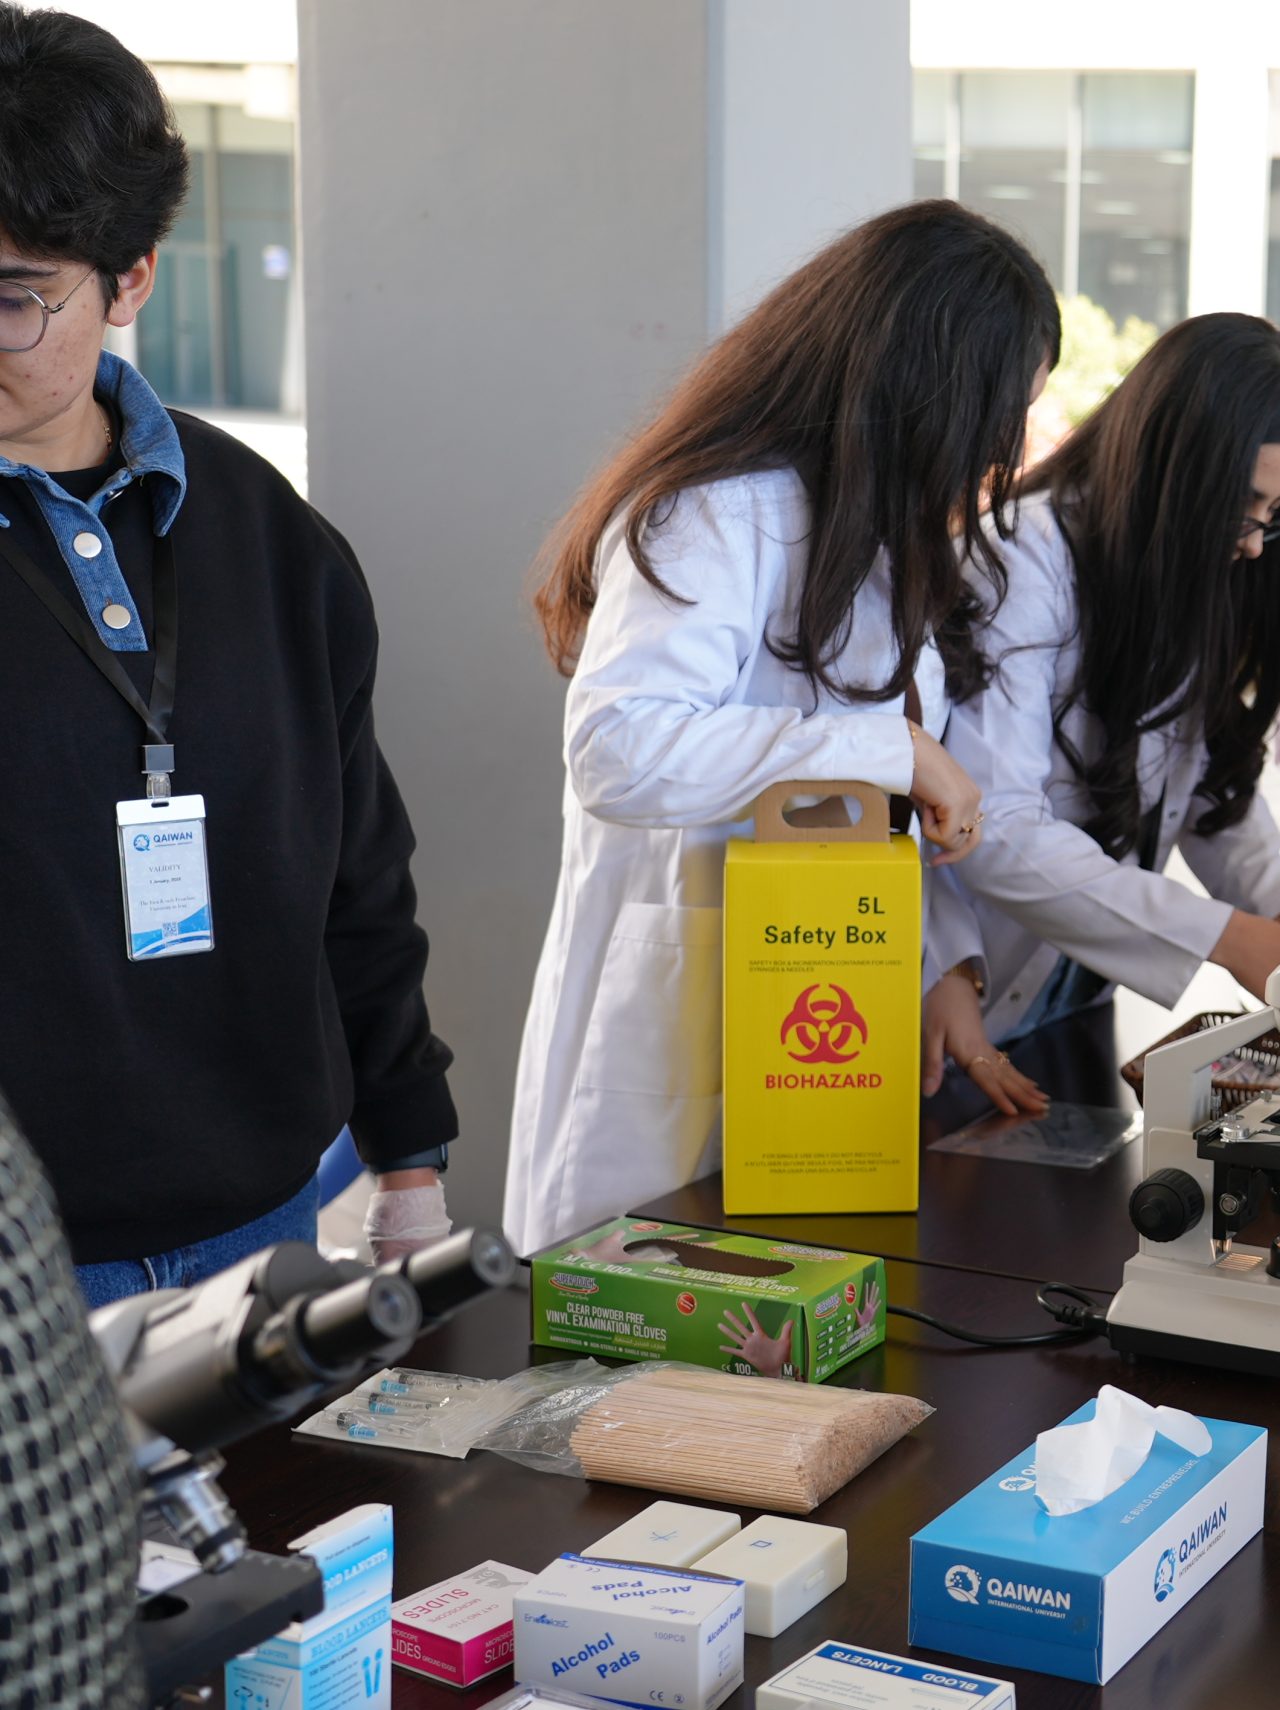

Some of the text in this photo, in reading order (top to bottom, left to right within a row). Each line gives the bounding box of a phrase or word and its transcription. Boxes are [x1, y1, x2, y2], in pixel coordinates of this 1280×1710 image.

[153, 832, 193, 843] QAIWAN
[149, 864, 181, 872] VALIDITY
[857, 896, 885, 914] 5L
[764, 925, 887, 949] Safety Box
[765, 1073, 883, 1089] BIOHAZARD
[546, 1309, 571, 1326] VINYL
[572, 1314, 631, 1336] EXAMINATION
[633, 1324, 667, 1342] GLOVES
[566, 1302, 645, 1326] CLEAR POWDER FREE
[734, 1362, 751, 1376] 100
[783, 1362, 793, 1376] M
[1119, 1514, 1135, 1525] WE
[1130, 1498, 1153, 1517] BUILD
[1179, 1501, 1227, 1563] QAIWAN
[343, 1547, 388, 1582] LANCETS
[1178, 1529, 1226, 1578] INTERNATIONAL UNIVERSITY
[592, 1579, 644, 1592] Pads
[612, 1584, 693, 1601] Alcohol
[986, 1577, 1071, 1610] QAIWAN
[402, 1588, 469, 1619] SLIDES
[429, 1597, 482, 1623] MICROSCOPE
[987, 1598, 1034, 1614] INTERNATIONAL
[311, 1605, 388, 1659] BLOOD LANCETS
[653, 1631, 686, 1643] 100PCS
[706, 1605, 742, 1645] Alcohol Pads
[484, 1638, 514, 1664] SLIDE
[550, 1632, 616, 1678] Alcohol
[596, 1650, 641, 1679] Pads
[831, 1650, 979, 1692] BLOOD LANCETS
